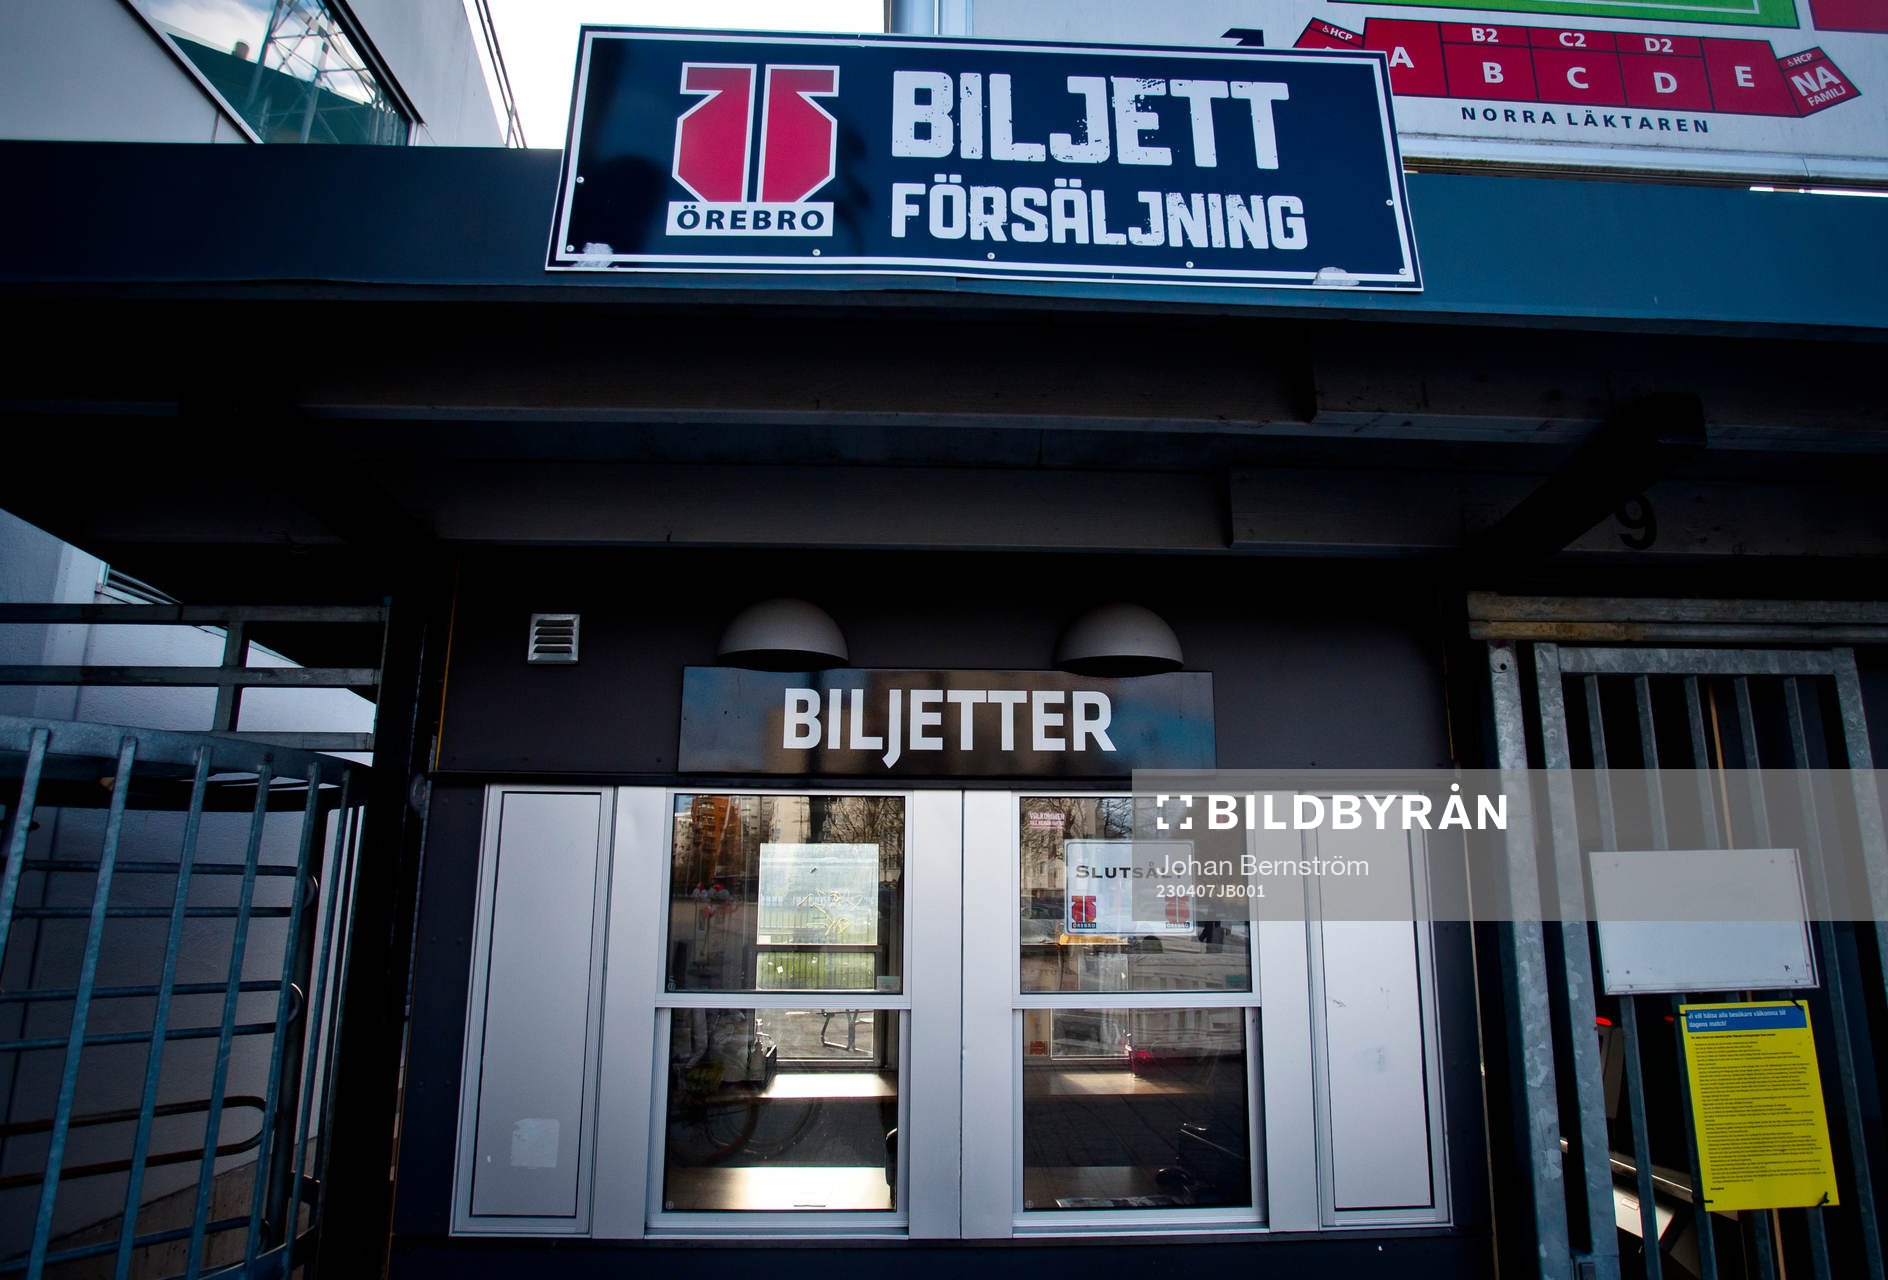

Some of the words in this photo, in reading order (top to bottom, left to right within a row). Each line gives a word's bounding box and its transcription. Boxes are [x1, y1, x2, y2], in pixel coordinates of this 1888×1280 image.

[1330, 27, 1353, 41] HCP
[1471, 27, 1499, 43] B2
[1559, 32, 1587, 47] C2
[1644, 37, 1674, 53] D2
[1389, 46, 1414, 68] A
[1792, 53, 1812, 65] HCP
[1482, 61, 1504, 84] B
[1566, 66, 1589, 89] C
[1653, 71, 1678, 94] D
[1734, 65, 1755, 87] E
[1791, 66, 1841, 97] NA
[1807, 85, 1846, 107] FAMILJ
[891, 70, 1290, 170] BILJETT
[1461, 106, 1556, 125] NORRA
[1567, 109, 1709, 134] LÄKTAREN
[676, 204, 825, 231] ÖREBRO
[890, 172, 1309, 250] FÖRSÄLJNING
[1615, 491, 1658, 551] 9
[783, 688, 1117, 769] BILJETTER
